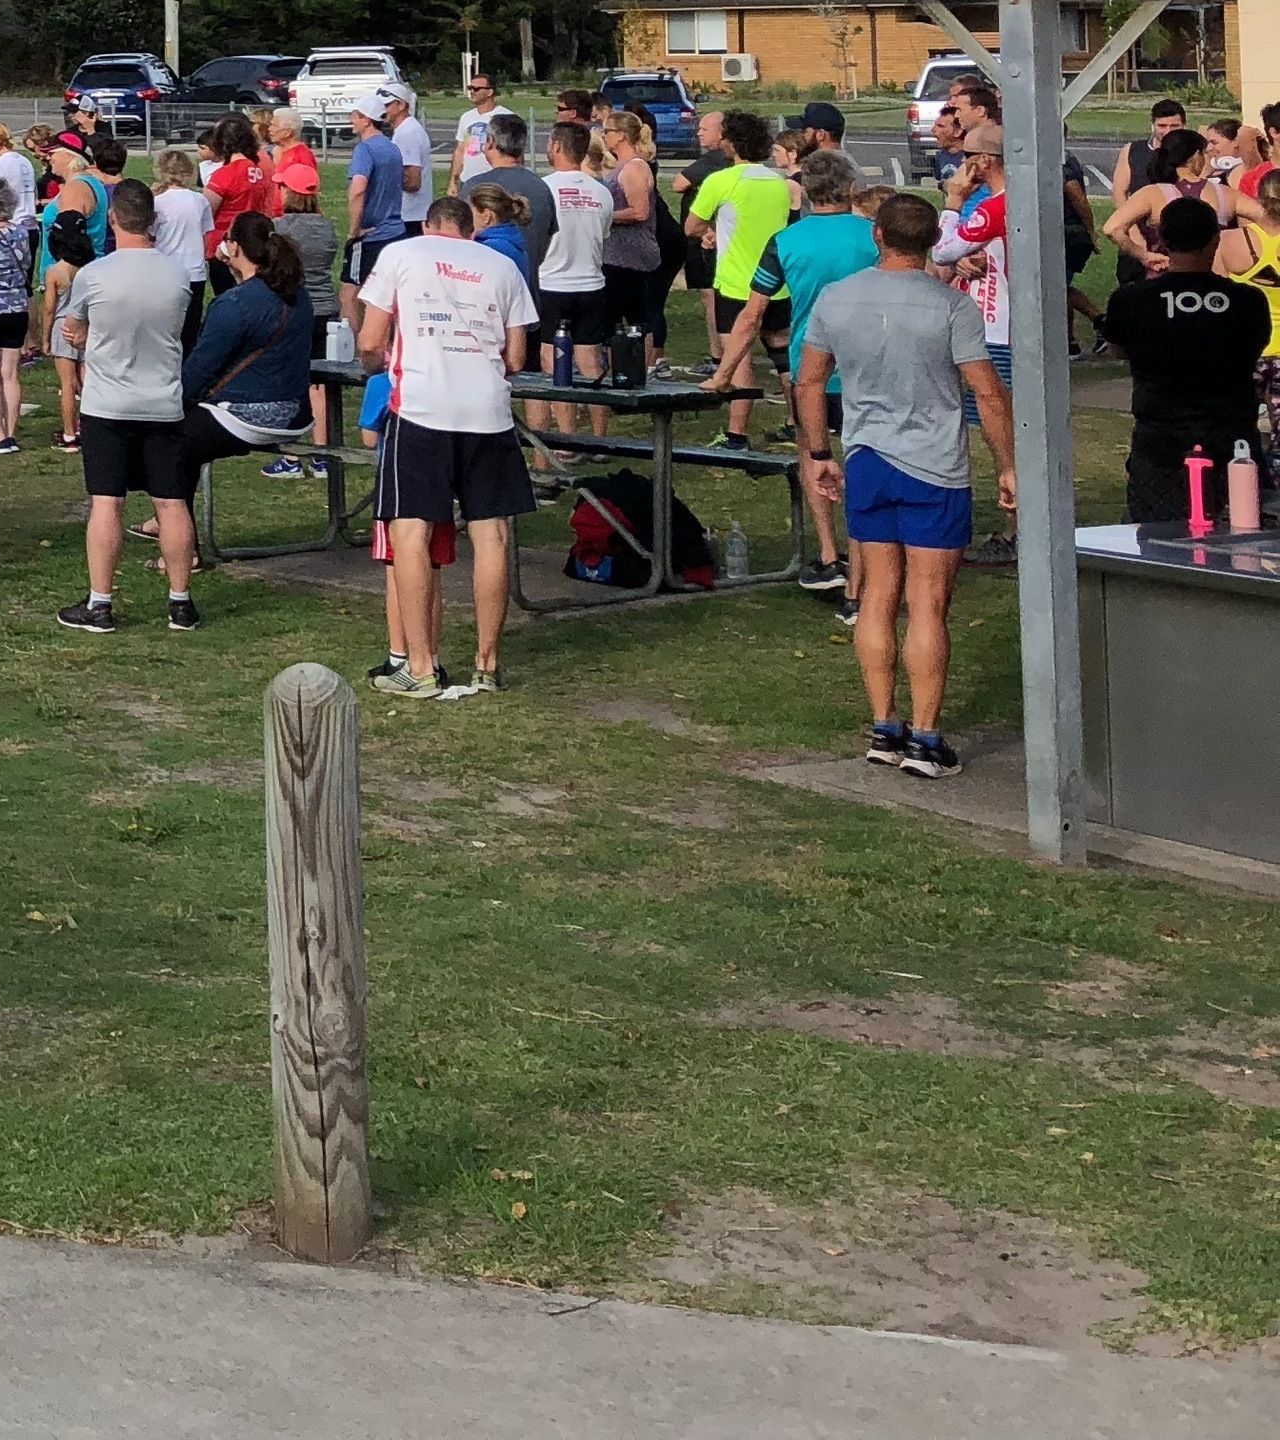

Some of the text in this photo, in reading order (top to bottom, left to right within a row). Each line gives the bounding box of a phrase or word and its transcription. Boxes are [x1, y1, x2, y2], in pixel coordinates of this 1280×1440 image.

[311, 97, 361, 107] TOYOT
[435, 261, 483, 283] Westfield
[1160, 291, 1230, 319] 100
